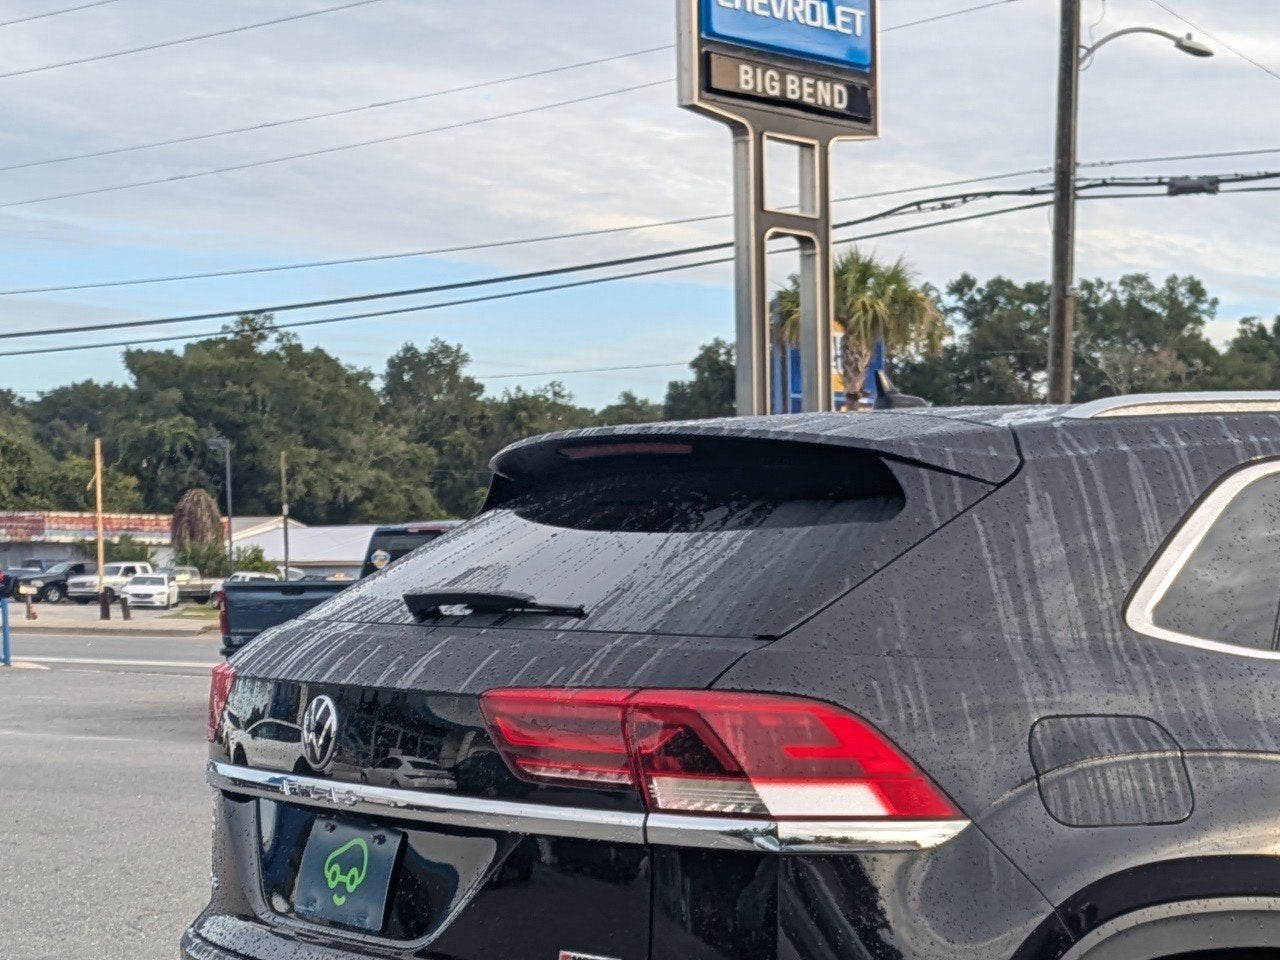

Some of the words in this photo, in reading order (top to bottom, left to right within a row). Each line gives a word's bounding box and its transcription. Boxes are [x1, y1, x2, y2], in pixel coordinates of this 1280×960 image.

[716, 0, 867, 37] EVROLET
[738, 64, 780, 96] BIG
[785, 74, 848, 110] BEND
